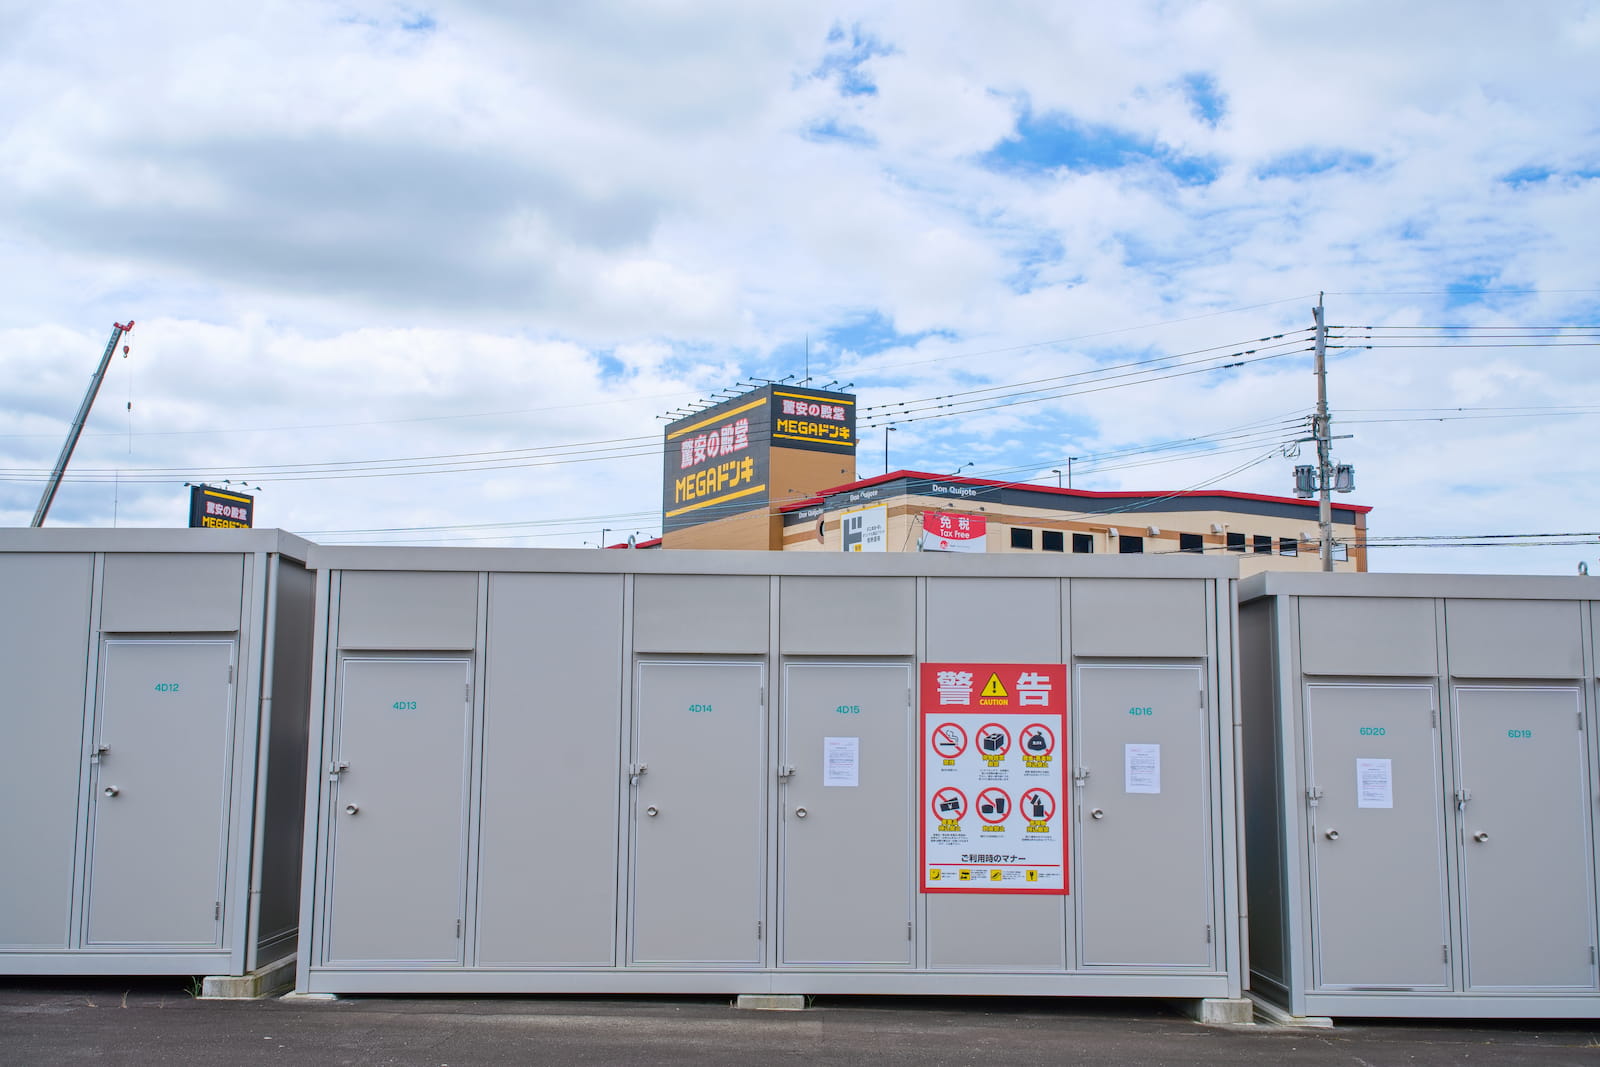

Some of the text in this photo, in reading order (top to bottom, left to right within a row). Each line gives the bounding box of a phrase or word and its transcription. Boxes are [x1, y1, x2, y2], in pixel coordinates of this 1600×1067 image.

[782, 399, 846, 421] 驚安の殿堂
[777, 418, 850, 440] MEGAドンキ
[680, 418, 749, 469] 驚安の殿堂
[675, 456, 754, 504] MEGAドンキ
[932, 484, 977, 496] Don Quijote
[940, 529, 970, 538] Tax Free
[155, 683, 179, 692] 4D12
[393, 701, 417, 710] 4D13
[688, 704, 712, 713] 4D14
[836, 705, 860, 714] 4D15
[1129, 707, 1152, 715] 4D16
[1359, 727, 1386, 736] 6D20
[1508, 730, 1531, 738] 6D19
[961, 854, 1026, 863] ご利用時のマナー
